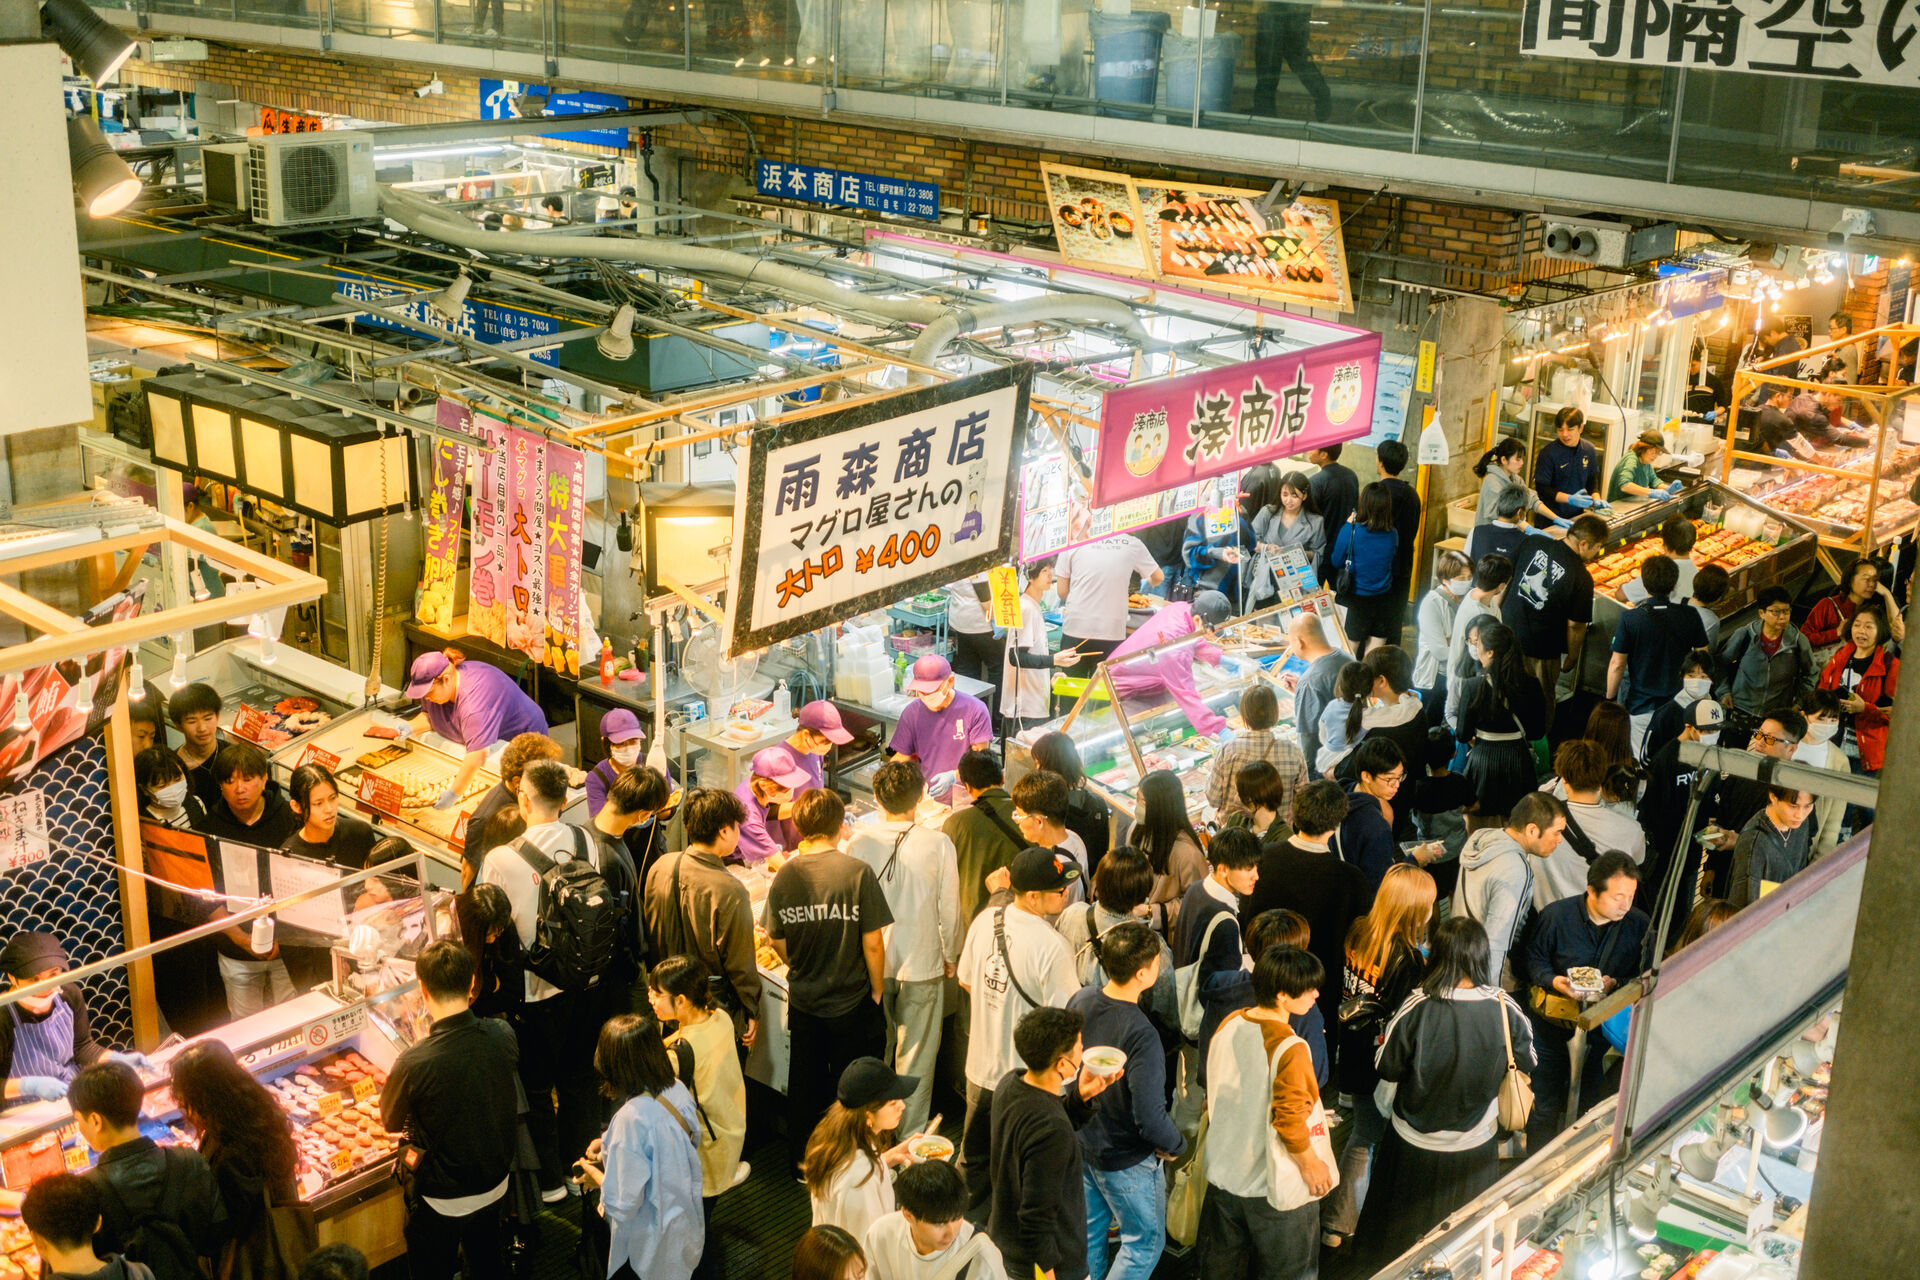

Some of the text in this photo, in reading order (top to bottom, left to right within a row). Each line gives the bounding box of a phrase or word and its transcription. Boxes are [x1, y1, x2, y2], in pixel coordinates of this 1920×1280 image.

[762, 163, 860, 204] 浜本商店
[1333, 361, 1360, 383] 湊商店
[1134, 408, 1168, 432] 湊商店
[1186, 366, 1313, 461] 湊商店
[775, 409, 990, 516] 雨森商店
[791, 478, 962, 551] マグロ屋さんの
[776, 523, 941, 609] 大トロ ¥400
[8, 848, 45, 868] ¥300
[779, 903, 860, 925] SSENTIALS
